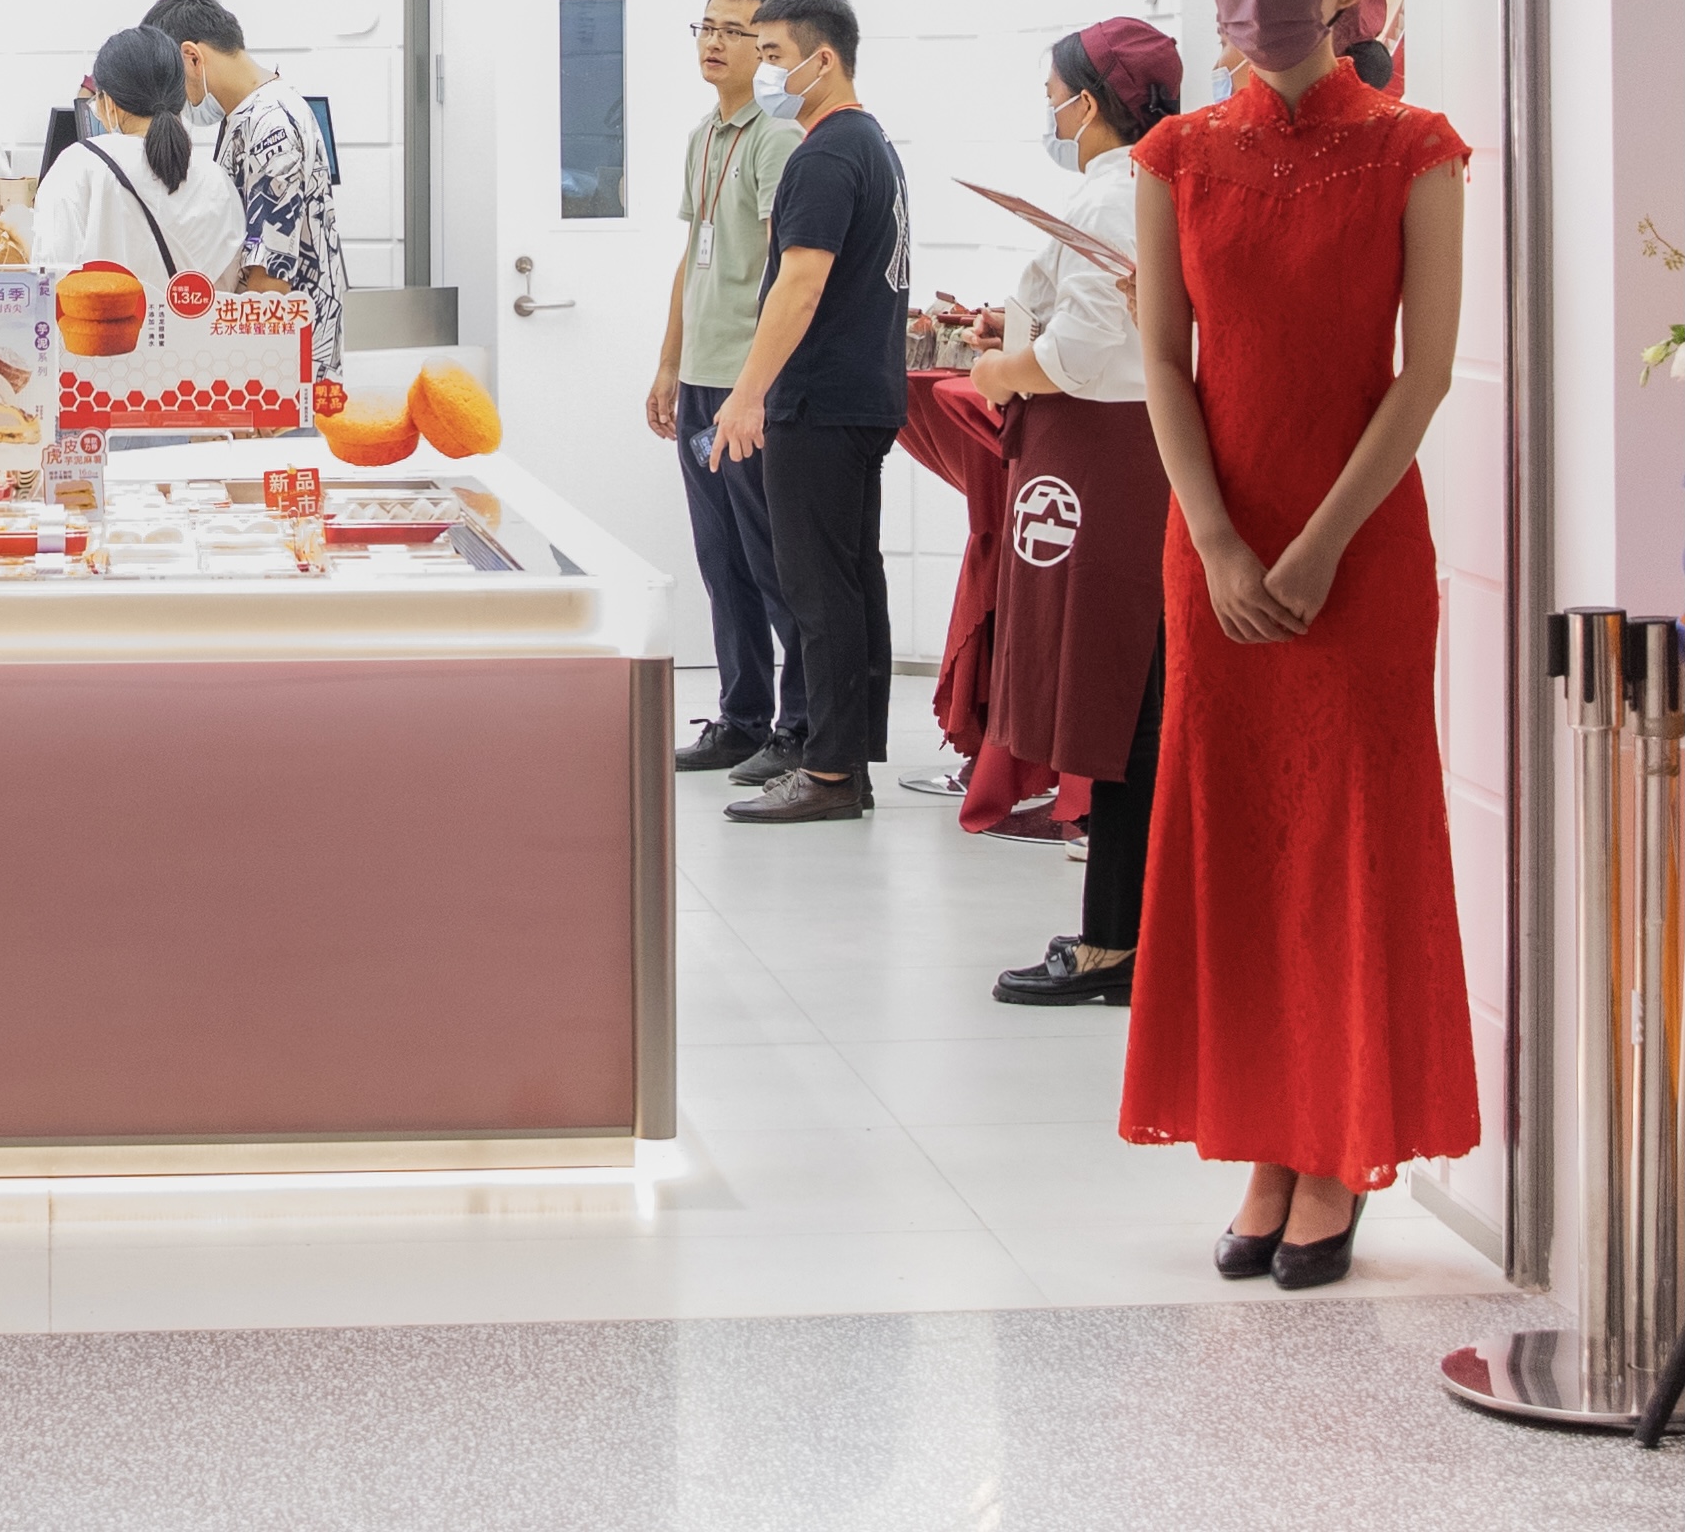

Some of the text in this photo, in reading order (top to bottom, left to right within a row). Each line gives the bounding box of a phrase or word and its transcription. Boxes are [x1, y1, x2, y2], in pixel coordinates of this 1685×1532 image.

[214, 298, 310, 323] 进店必买
[209, 322, 296, 336] 无水蜂蜜蛋糕
[269, 471, 315, 494] 新品
